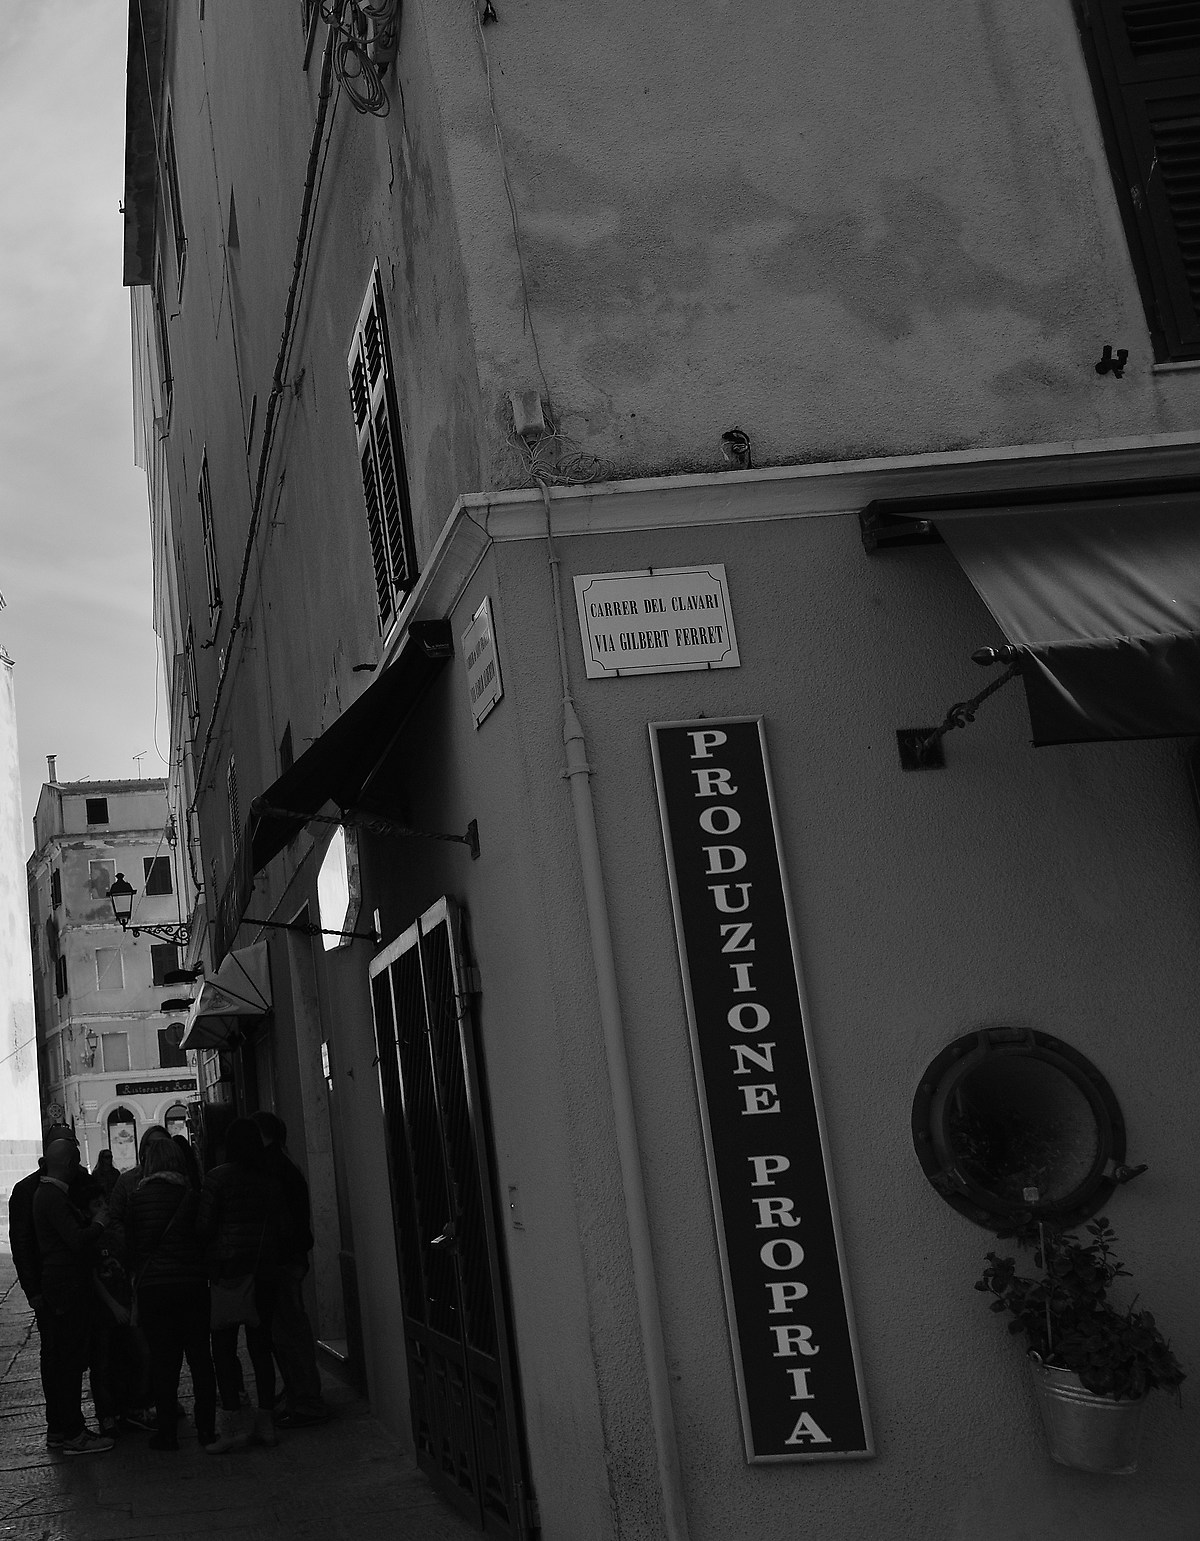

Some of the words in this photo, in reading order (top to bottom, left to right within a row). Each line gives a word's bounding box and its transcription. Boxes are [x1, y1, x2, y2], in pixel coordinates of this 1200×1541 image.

[590, 600, 638, 617] CARRER
[643, 598, 667, 614] DEL
[671, 594, 719, 612] CLAVARI
[594, 633, 616, 653] VIA
[619, 629, 670, 651] GILBERT
[675, 625, 723, 647] FERRET
[686, 729, 781, 1116] PRODUZIONE
[746, 1154, 832, 1446] PROPRIA
